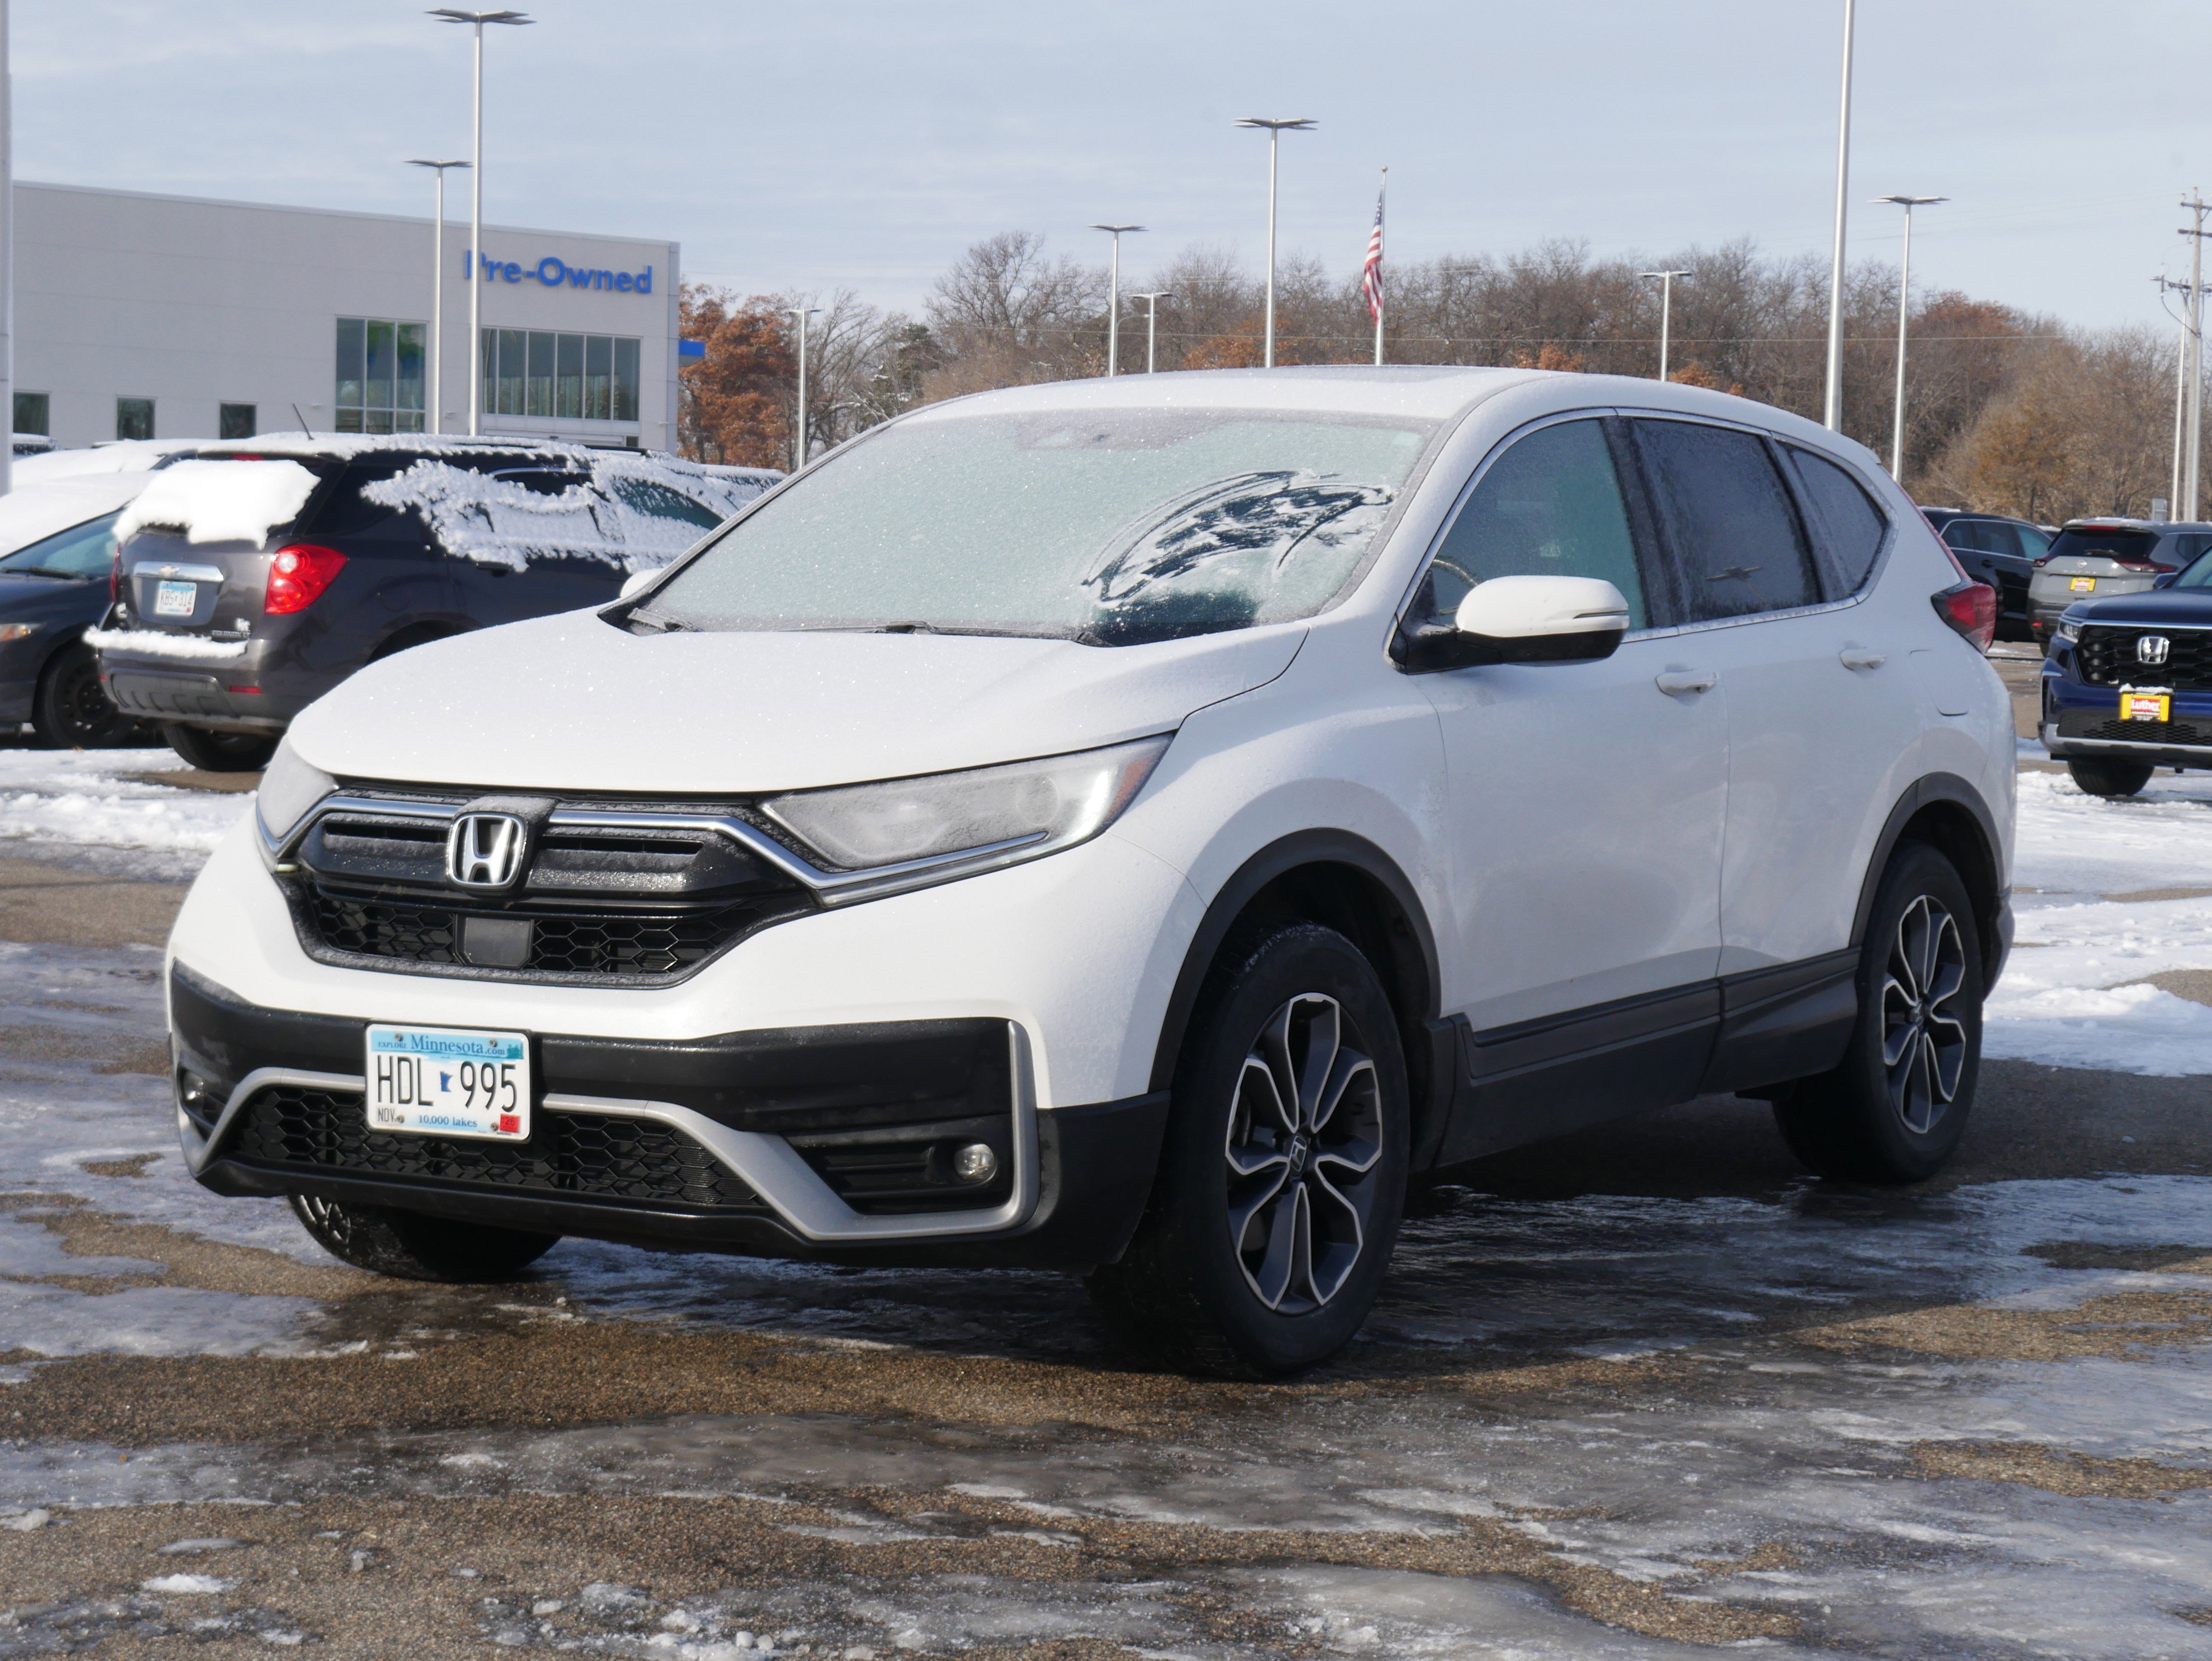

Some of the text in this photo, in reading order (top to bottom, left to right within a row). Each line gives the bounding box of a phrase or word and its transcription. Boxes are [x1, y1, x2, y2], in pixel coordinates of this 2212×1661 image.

[465, 250, 653, 293] Pre-Owned
[377, 1055, 517, 1112] HDL 995
[418, 1115, 477, 1127] 10,000 lakes
